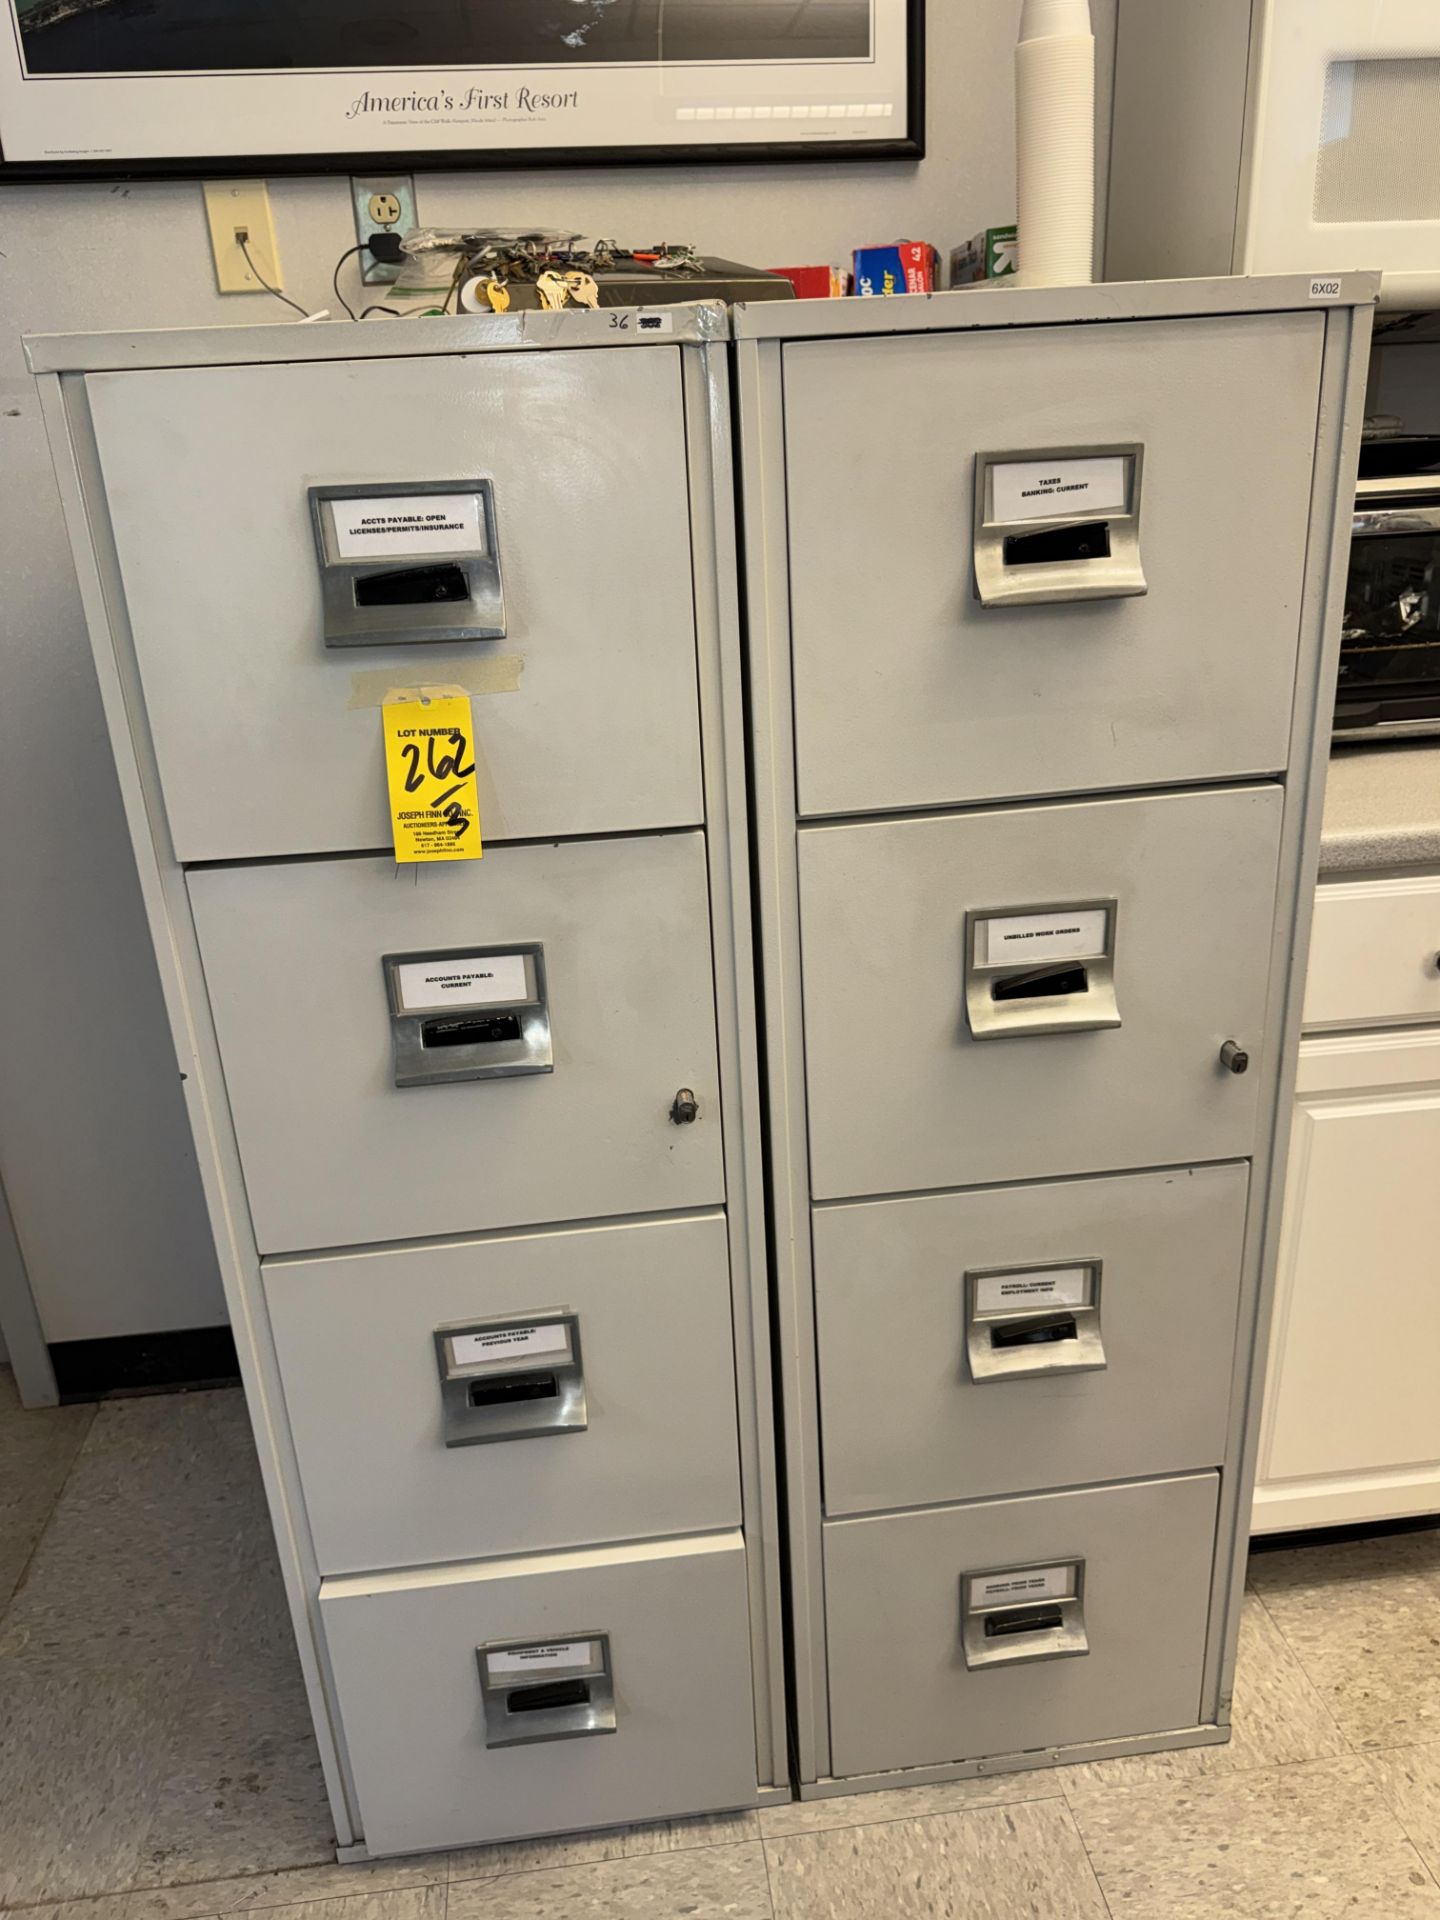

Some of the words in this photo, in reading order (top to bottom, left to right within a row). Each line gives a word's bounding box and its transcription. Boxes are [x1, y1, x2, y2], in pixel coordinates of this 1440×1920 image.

[346, 89, 453, 119] America's
[459, 87, 508, 110] First
[515, 86, 578, 112] Resort
[1311, 283, 1339, 294] 6X02
[609, 313, 628, 329] 36
[1038, 478, 1061, 486] TAXES
[1021, 488, 1055, 497] BANKING:
[1056, 483, 1088, 492] CURRENT
[388, 516, 424, 524] PAYABLE:
[425, 514, 446, 522] OPEN
[349, 523, 464, 535] LICENSES/PERMITS/INSURANCE
[397, 729, 416, 738] LOT
[419, 727, 460, 737] NUMBER
[401, 734, 476, 793] 262
[397, 811, 424, 820] JOSEPH
[426, 810, 441, 818] FINN
[425, 975, 460, 983] ACCOUNTS
